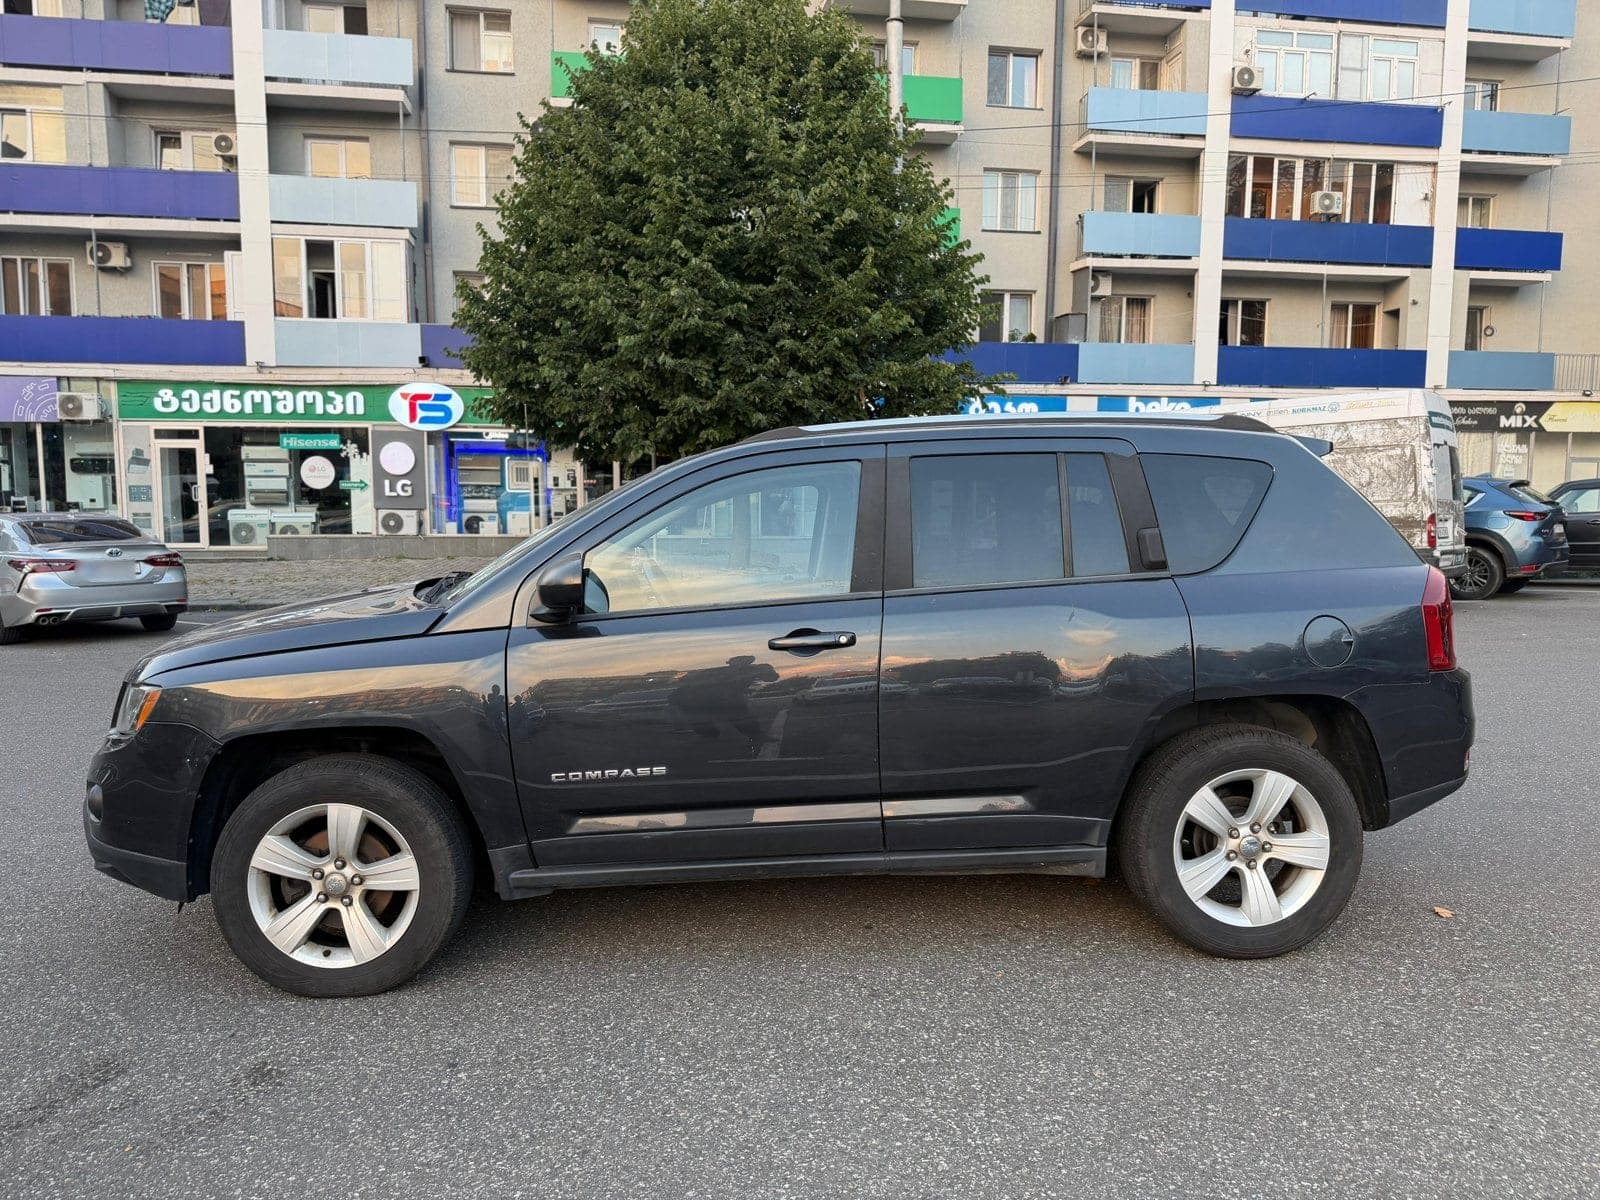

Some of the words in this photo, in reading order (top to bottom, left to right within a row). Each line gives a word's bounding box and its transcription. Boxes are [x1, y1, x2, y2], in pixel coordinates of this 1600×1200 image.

[153, 388, 365, 415] ტექნოშოპი
[400, 393, 453, 424] TS
[1291, 405, 1327, 415] KORKMAZ
[1499, 415, 1538, 428] MIX
[283, 436, 339, 447] Hisense
[384, 479, 413, 497] LG
[550, 766, 667, 783] COMPASS
